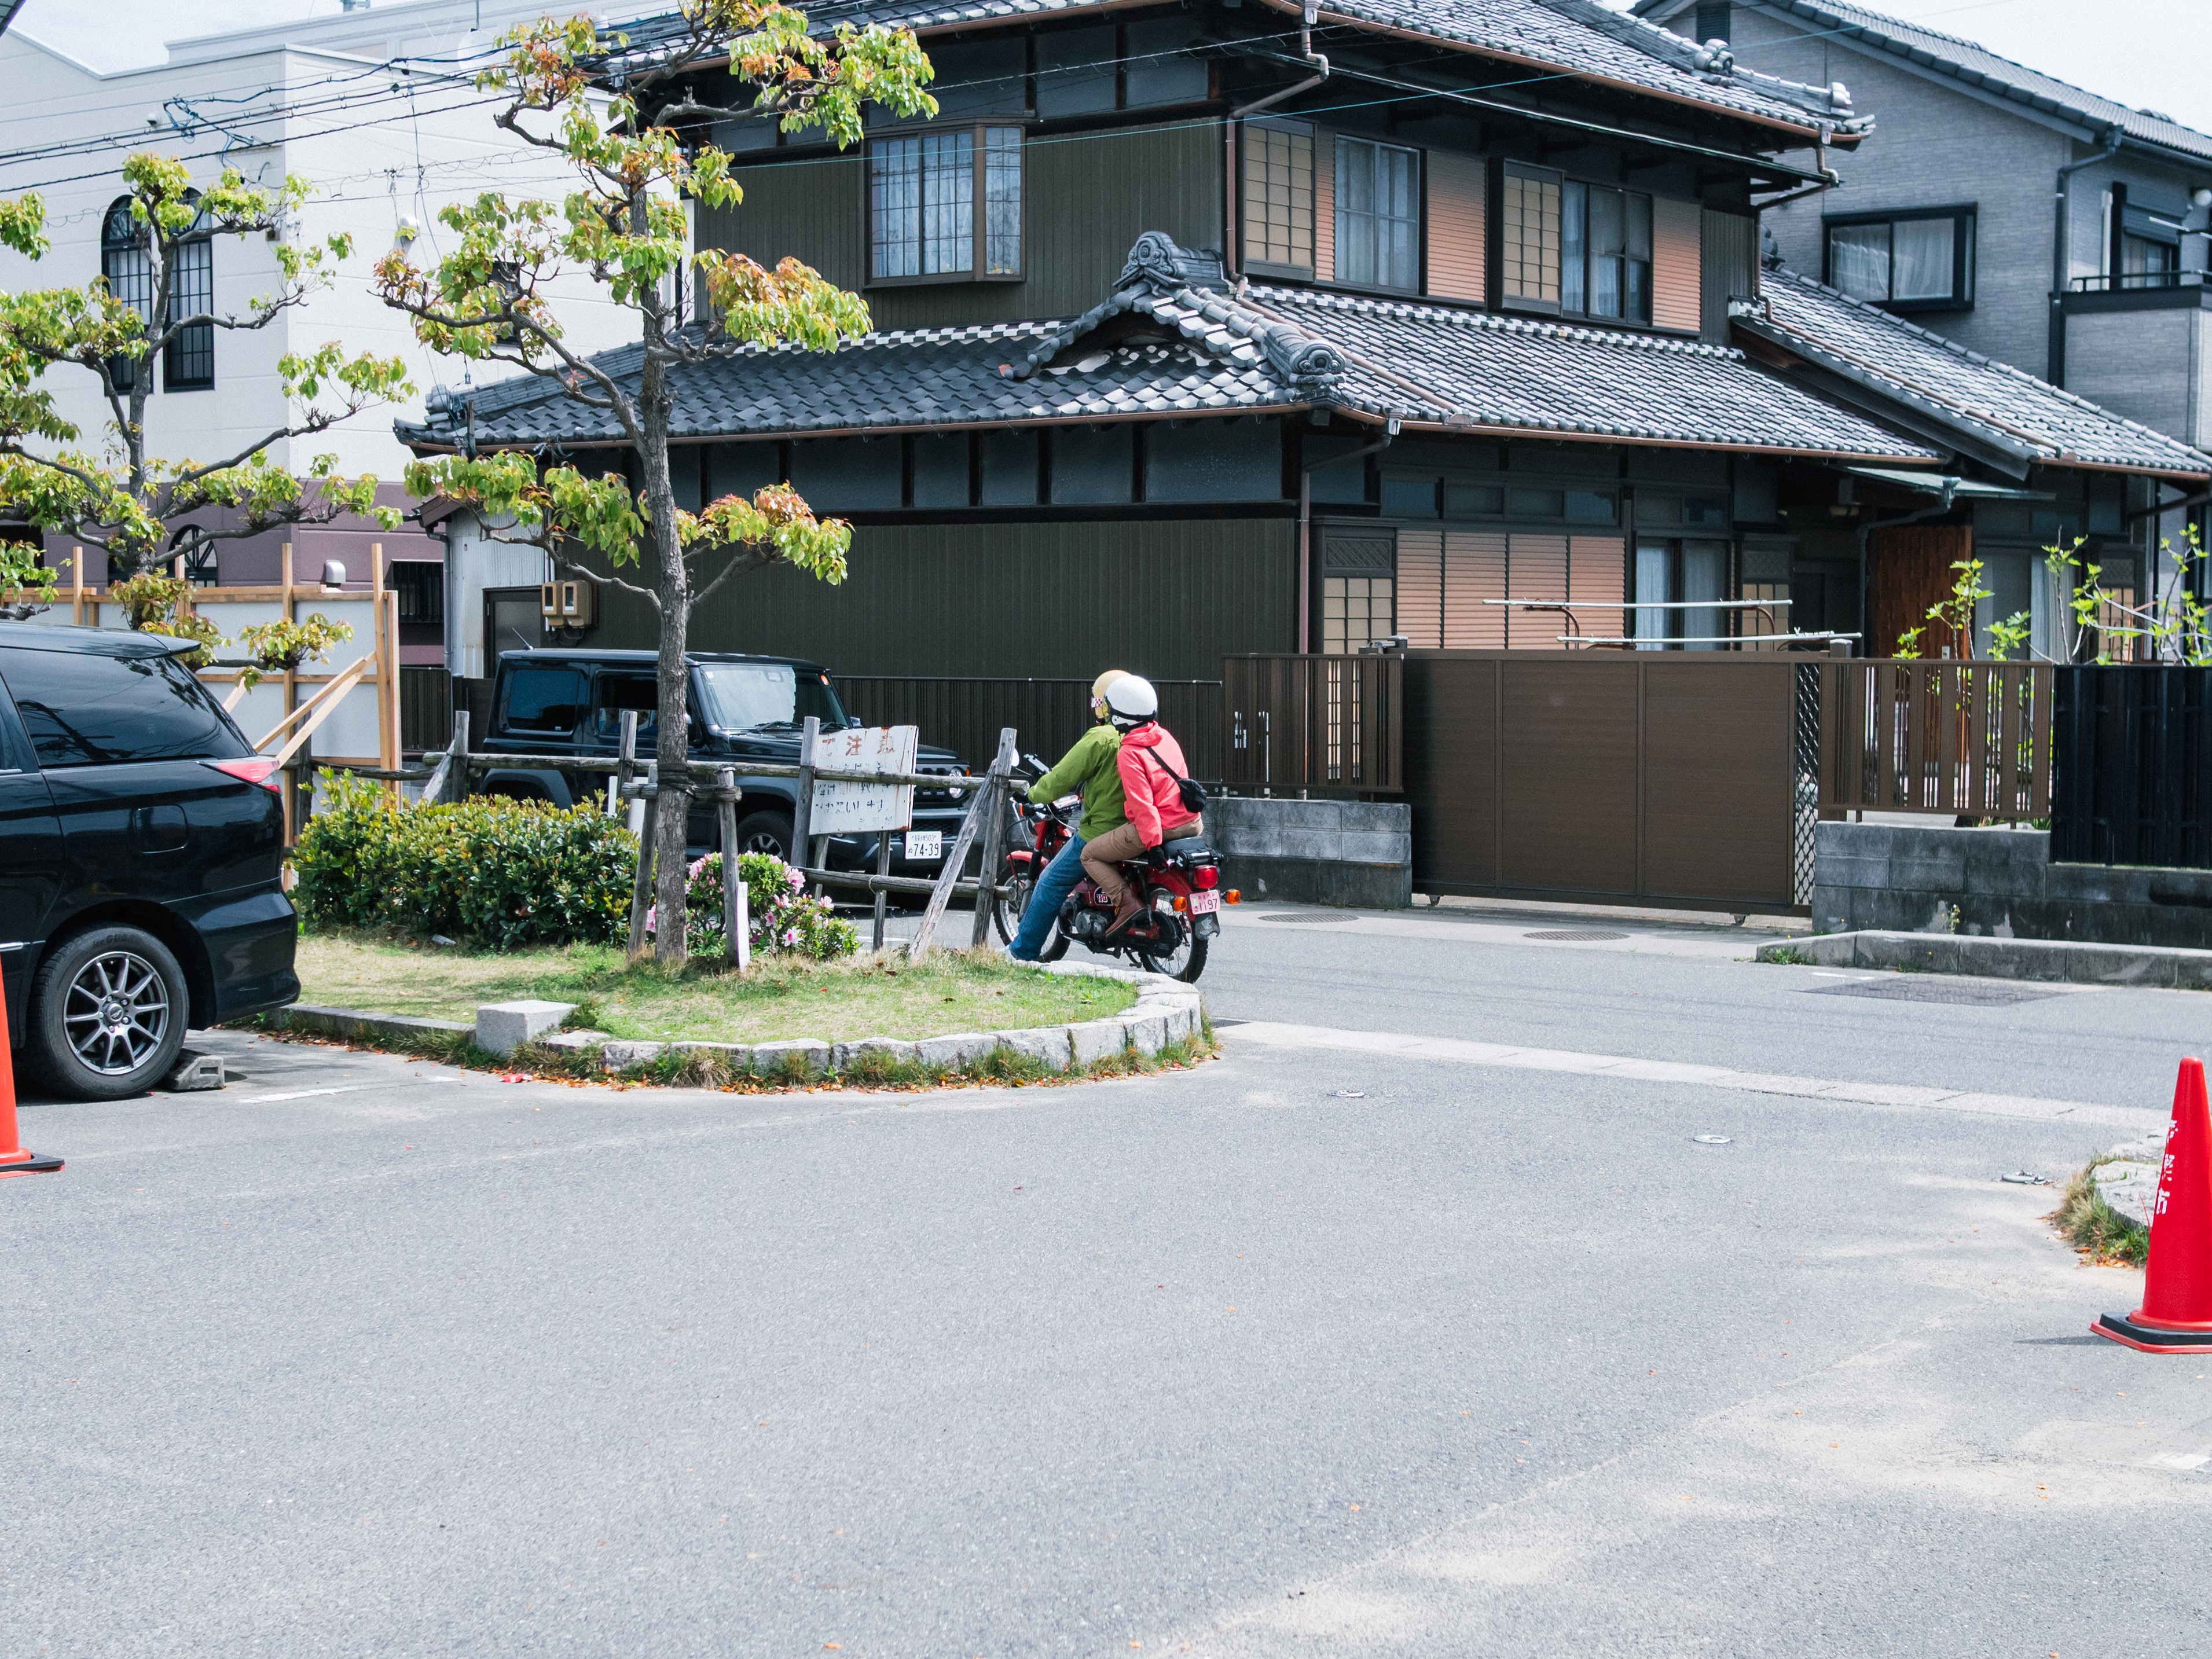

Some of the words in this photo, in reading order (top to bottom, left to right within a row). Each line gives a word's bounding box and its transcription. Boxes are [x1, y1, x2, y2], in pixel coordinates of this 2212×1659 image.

[914, 843, 939, 857] 74-39
[1199, 898, 1217, 912] 1197
[93, 933, 139, 946] iceGUA
